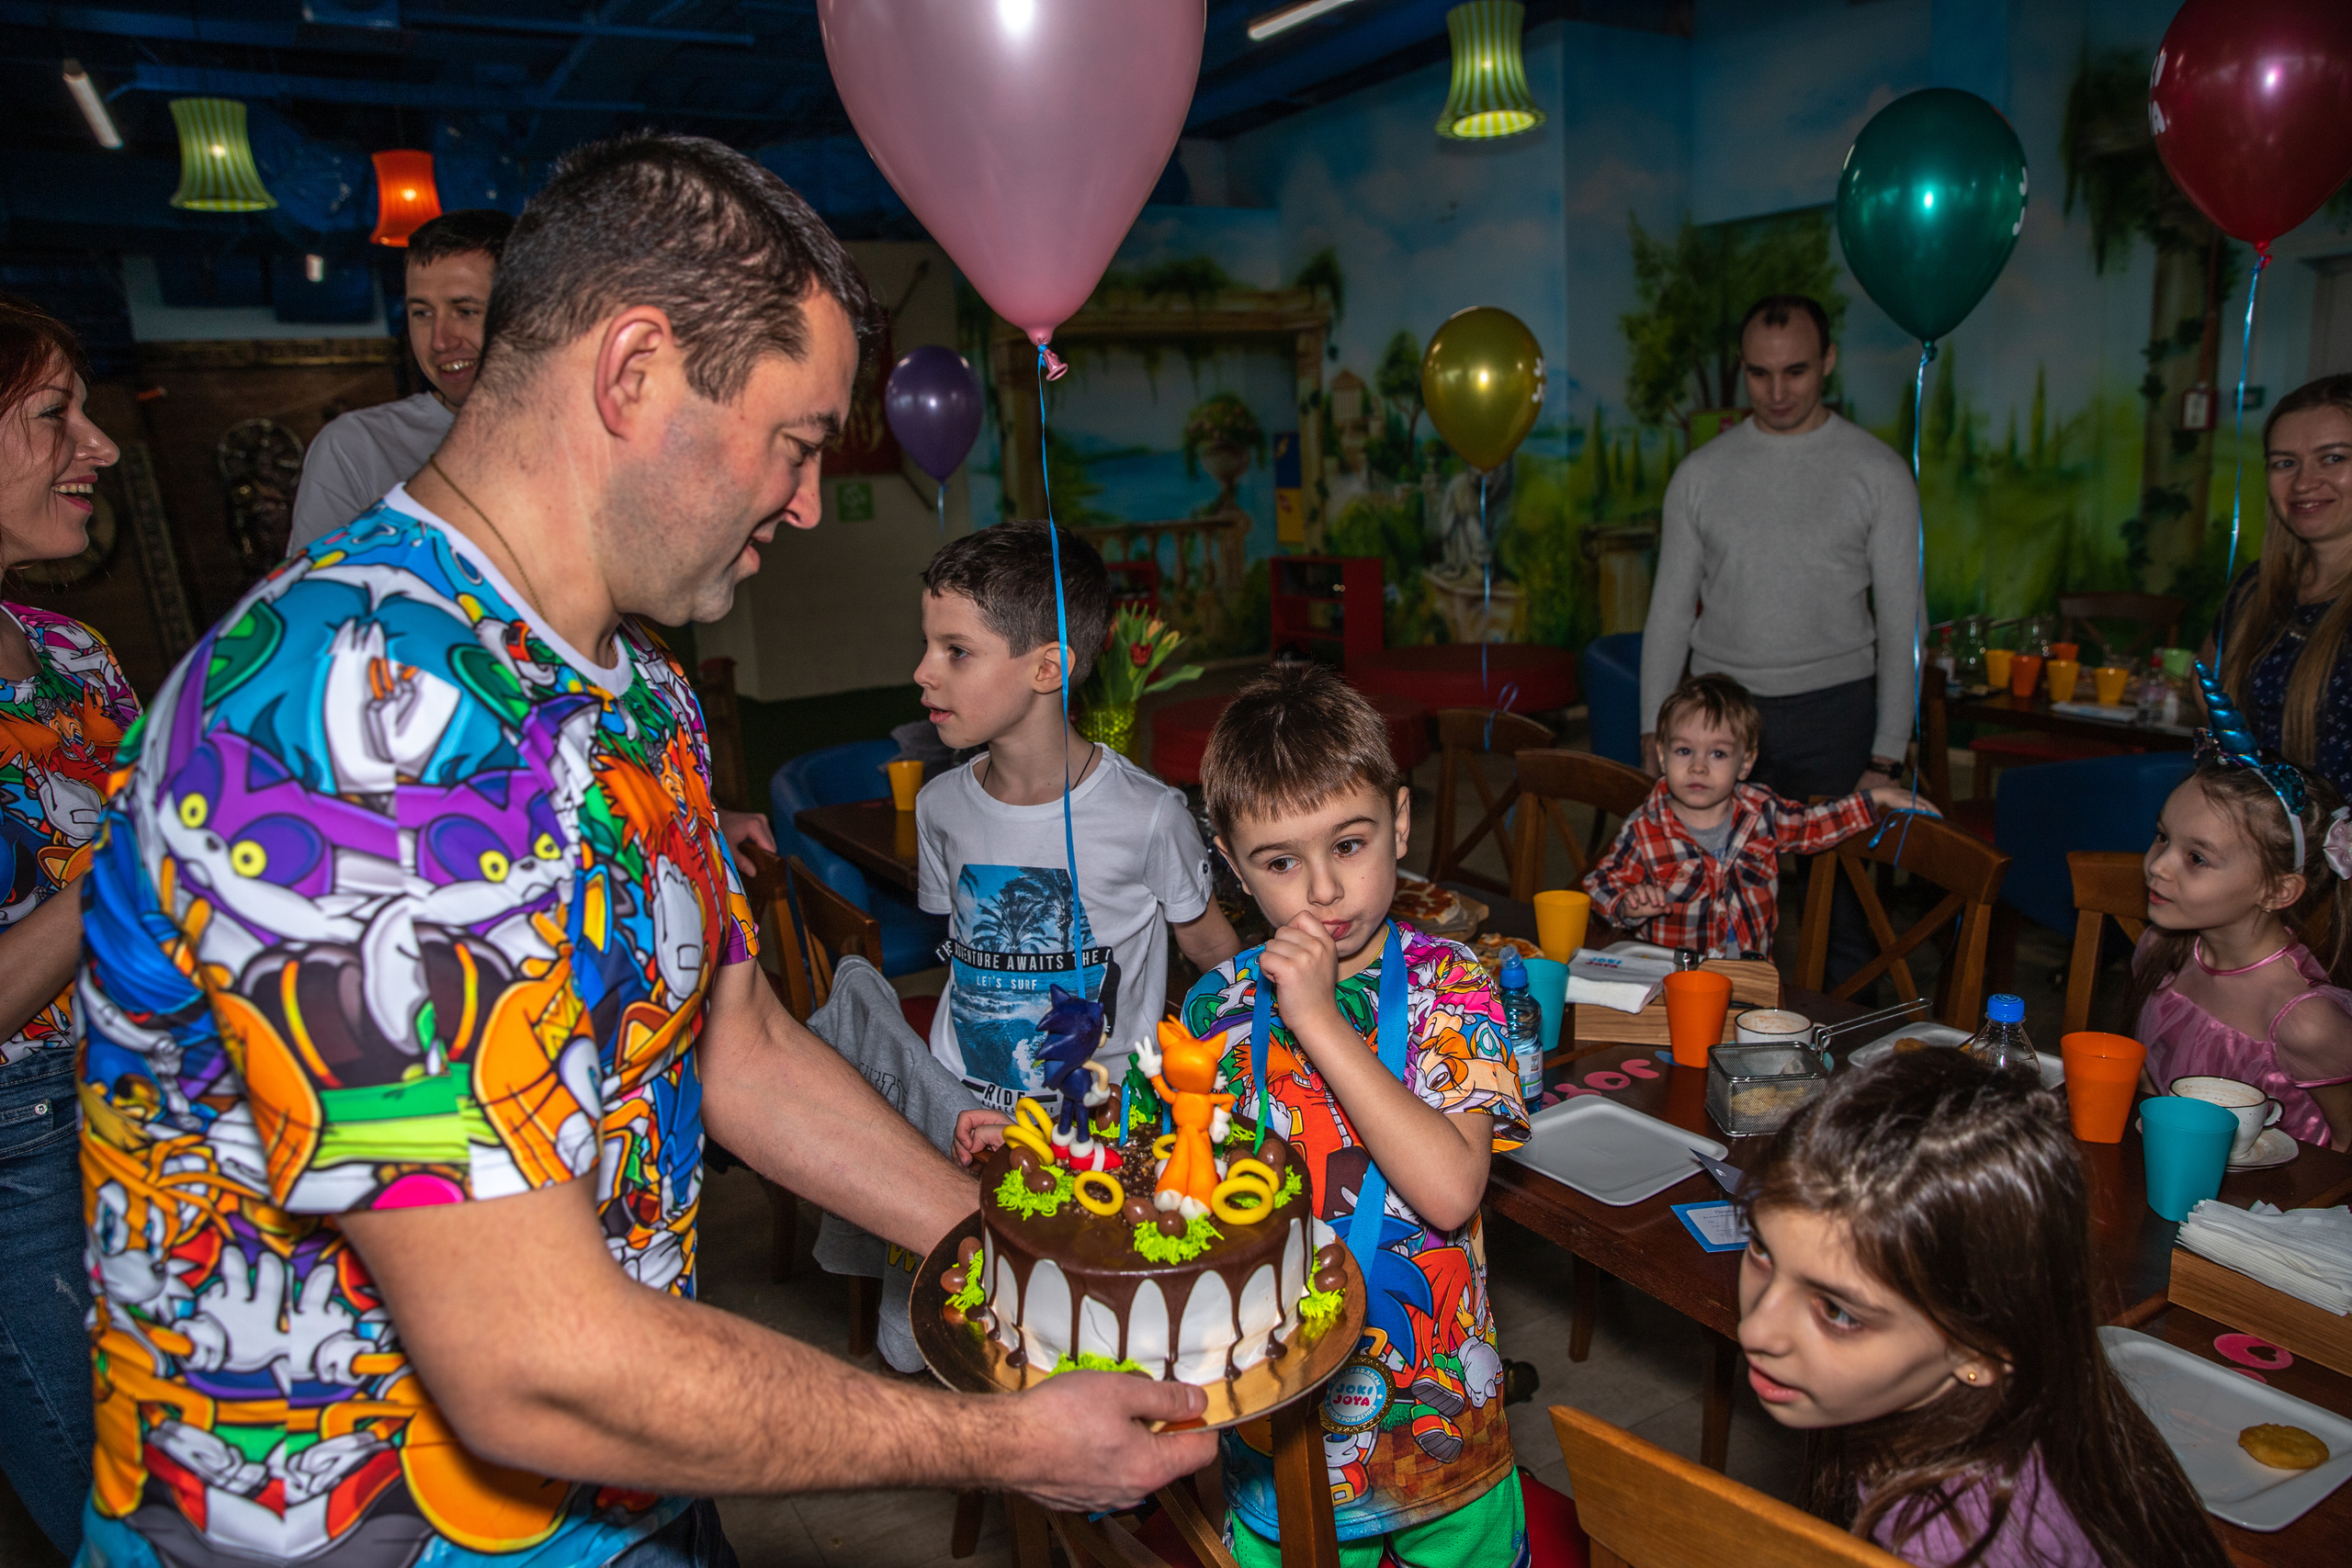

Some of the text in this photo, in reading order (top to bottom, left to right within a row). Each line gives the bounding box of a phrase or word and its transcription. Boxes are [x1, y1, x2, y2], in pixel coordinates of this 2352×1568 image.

[1006, 954, 1064, 971] AWAITS
[977, 976, 1037, 990] LET'S SURF
[1332, 1369, 1381, 1385] ПОЗДРАВЛЯЕМ
[1336, 1383, 1373, 1394] JOKI
[1333, 1394, 1369, 1406] JOYA
[1341, 1405, 1376, 1422] РОЖДЕНИЯ
